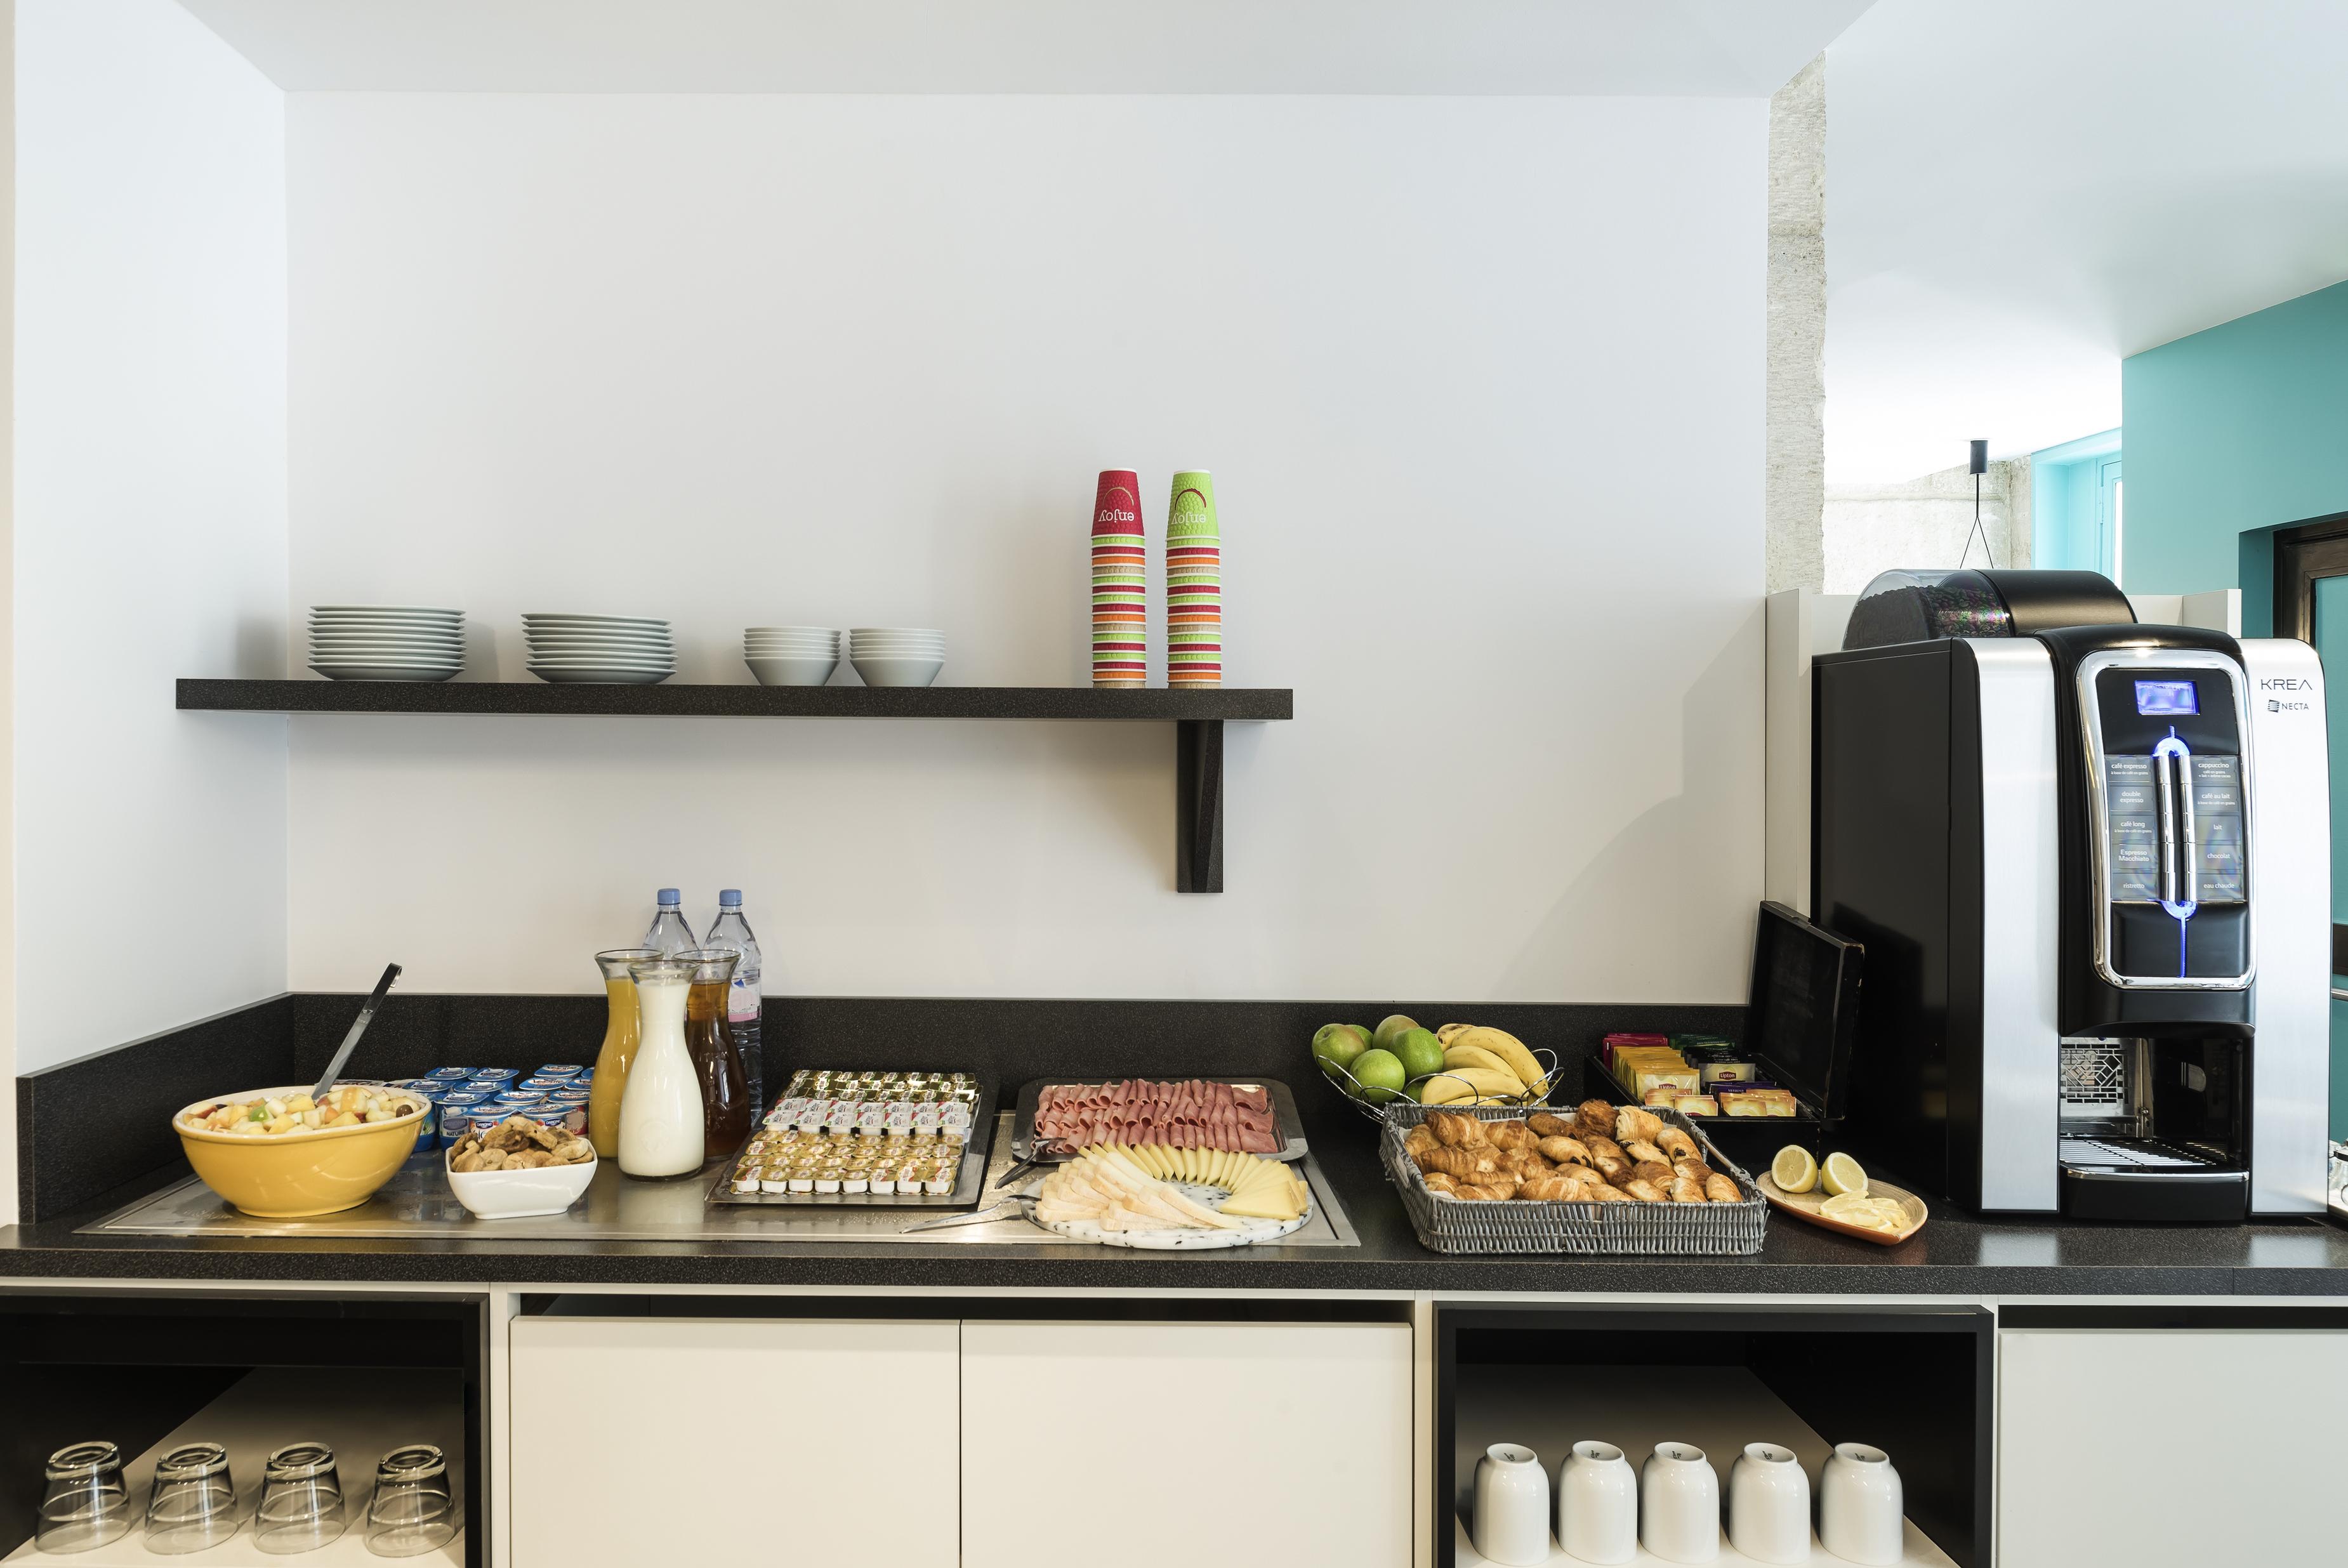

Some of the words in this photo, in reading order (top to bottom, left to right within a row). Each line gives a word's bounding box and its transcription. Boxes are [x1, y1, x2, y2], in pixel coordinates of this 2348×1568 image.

[1098, 509, 1135, 523] enjoy
[1171, 511, 1206, 525] enjoy
[2260, 679, 2312, 690] KREA
